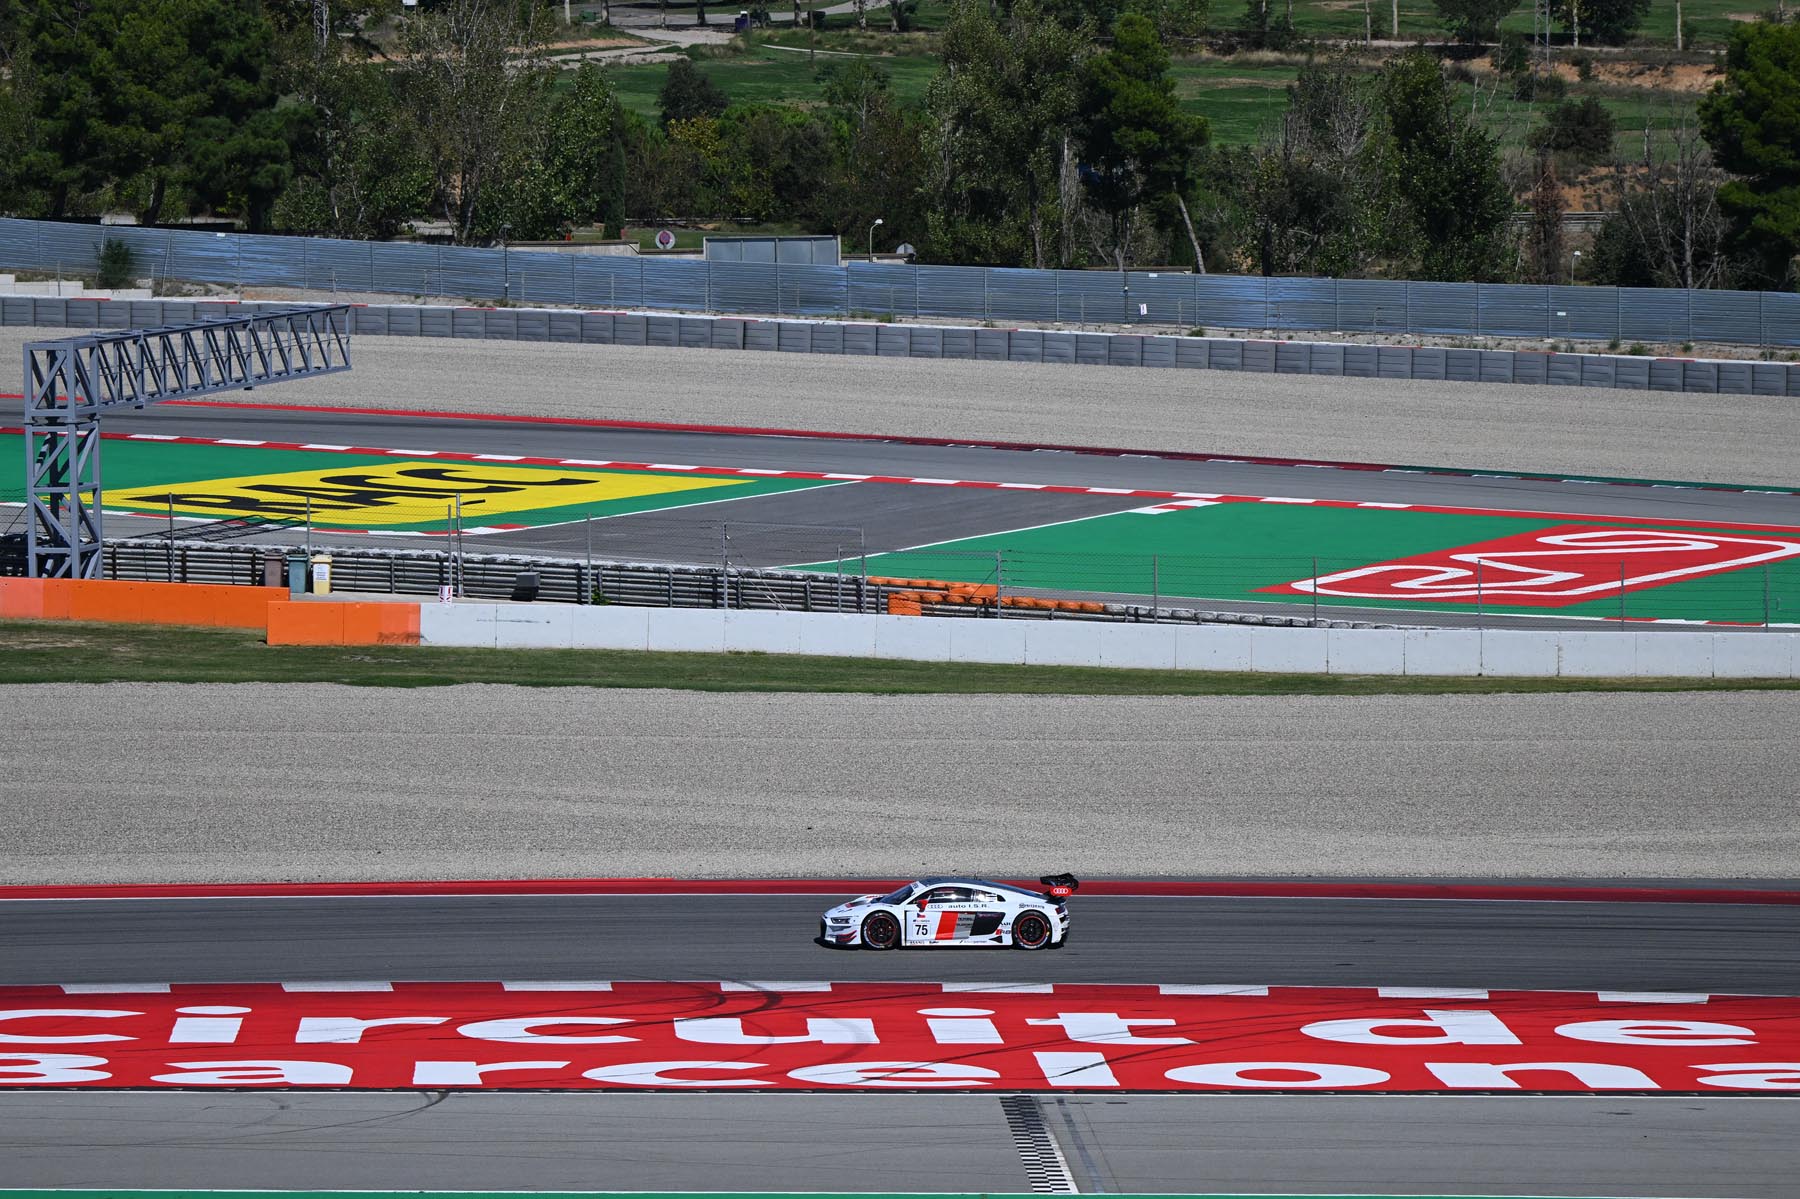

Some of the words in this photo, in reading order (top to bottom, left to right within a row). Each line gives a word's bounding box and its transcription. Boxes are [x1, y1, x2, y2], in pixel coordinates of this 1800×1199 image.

[125, 468, 600, 514] RACC
[915, 924, 928, 936] 75
[1300, 1009, 1761, 1046] de
